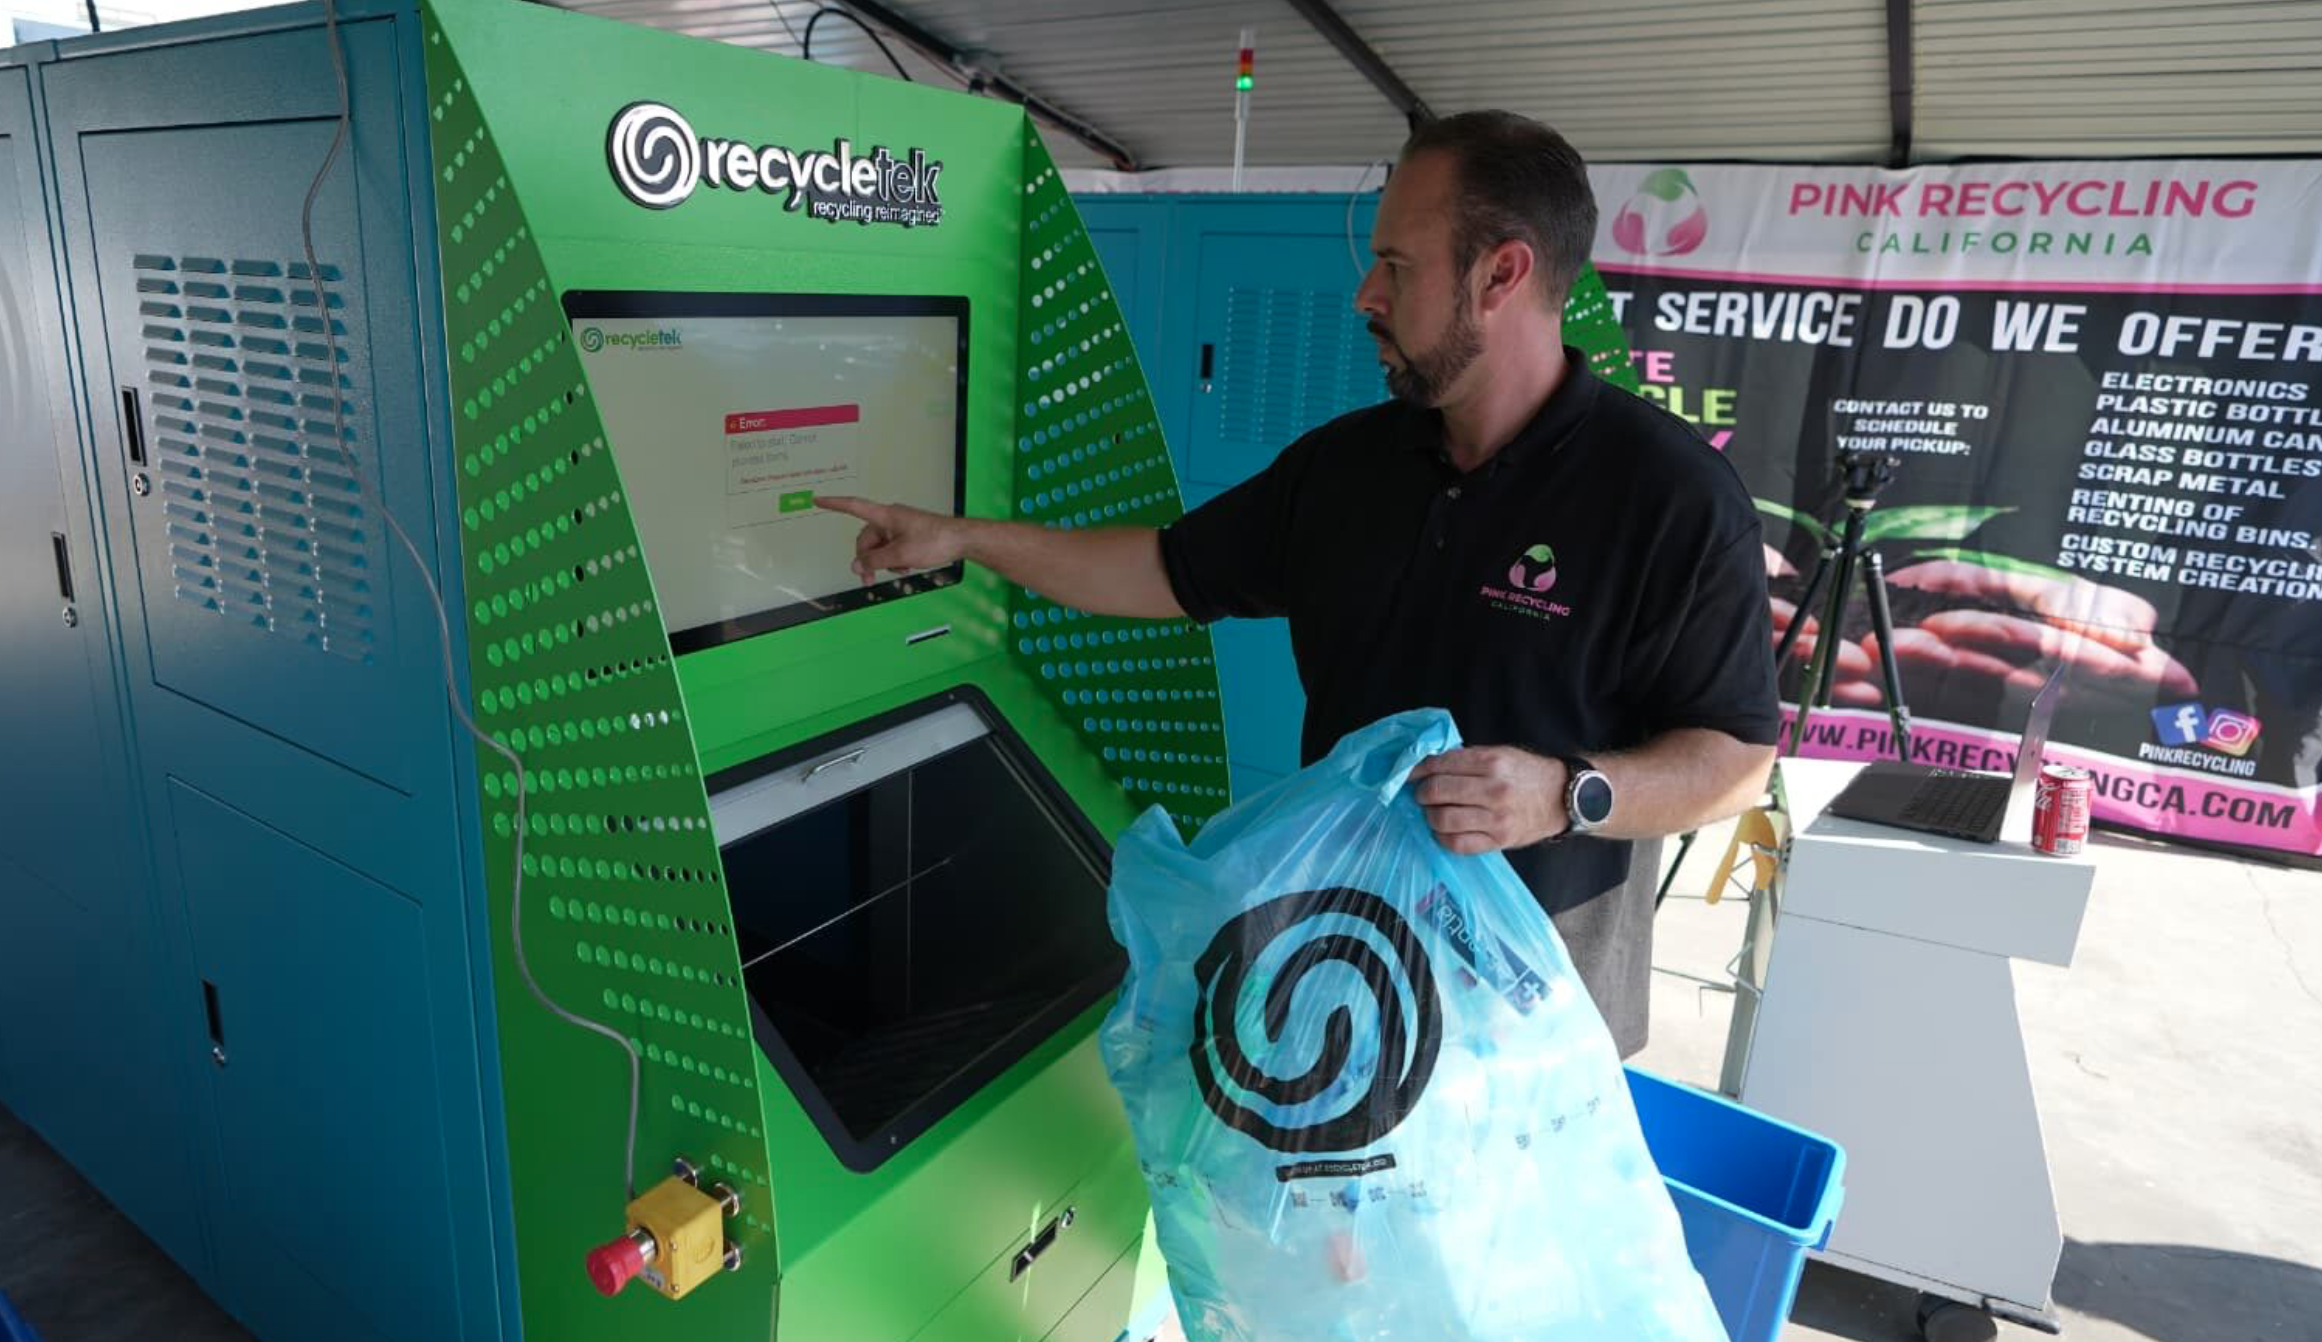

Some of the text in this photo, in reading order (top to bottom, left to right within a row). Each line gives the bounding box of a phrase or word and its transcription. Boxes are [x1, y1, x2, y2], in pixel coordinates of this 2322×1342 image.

[702, 137, 942, 209] recycletek
[813, 200, 872, 223] recycling
[1788, 180, 2259, 218] PINK RECYCLING
[1856, 232, 2153, 255] CALIFORNIA
[604, 328, 682, 351] recycletek
[1654, 291, 1862, 347] SERVICE
[1883, 295, 1961, 349] DO
[1991, 299, 2088, 353] WE
[2117, 311, 2322, 362] OFFER
[2101, 371, 2310, 401] ELECTRONICS
[1833, 399, 1989, 419] CONTACT US TO
[2095, 393, 2218, 419] PLASTIC
[1853, 418, 1959, 436] SCHEDULE
[2090, 417, 2256, 447] ALUMINUM
[1836, 435, 1972, 456] YOUR PICKUP:
[2084, 440, 2322, 478] GLASS BOTTLES
[2078, 463, 2287, 500] SCRAP METAL
[2071, 488, 2245, 523] RENTING OF
[2066, 505, 2317, 550] RECYCLING BINS.
[2061, 533, 2178, 565] CUSTOM
[2057, 551, 2171, 582] SYSTEM
[1481, 585, 1571, 617] PINK RECYCLING
[2139, 742, 2256, 776] PINKRECYCLING
